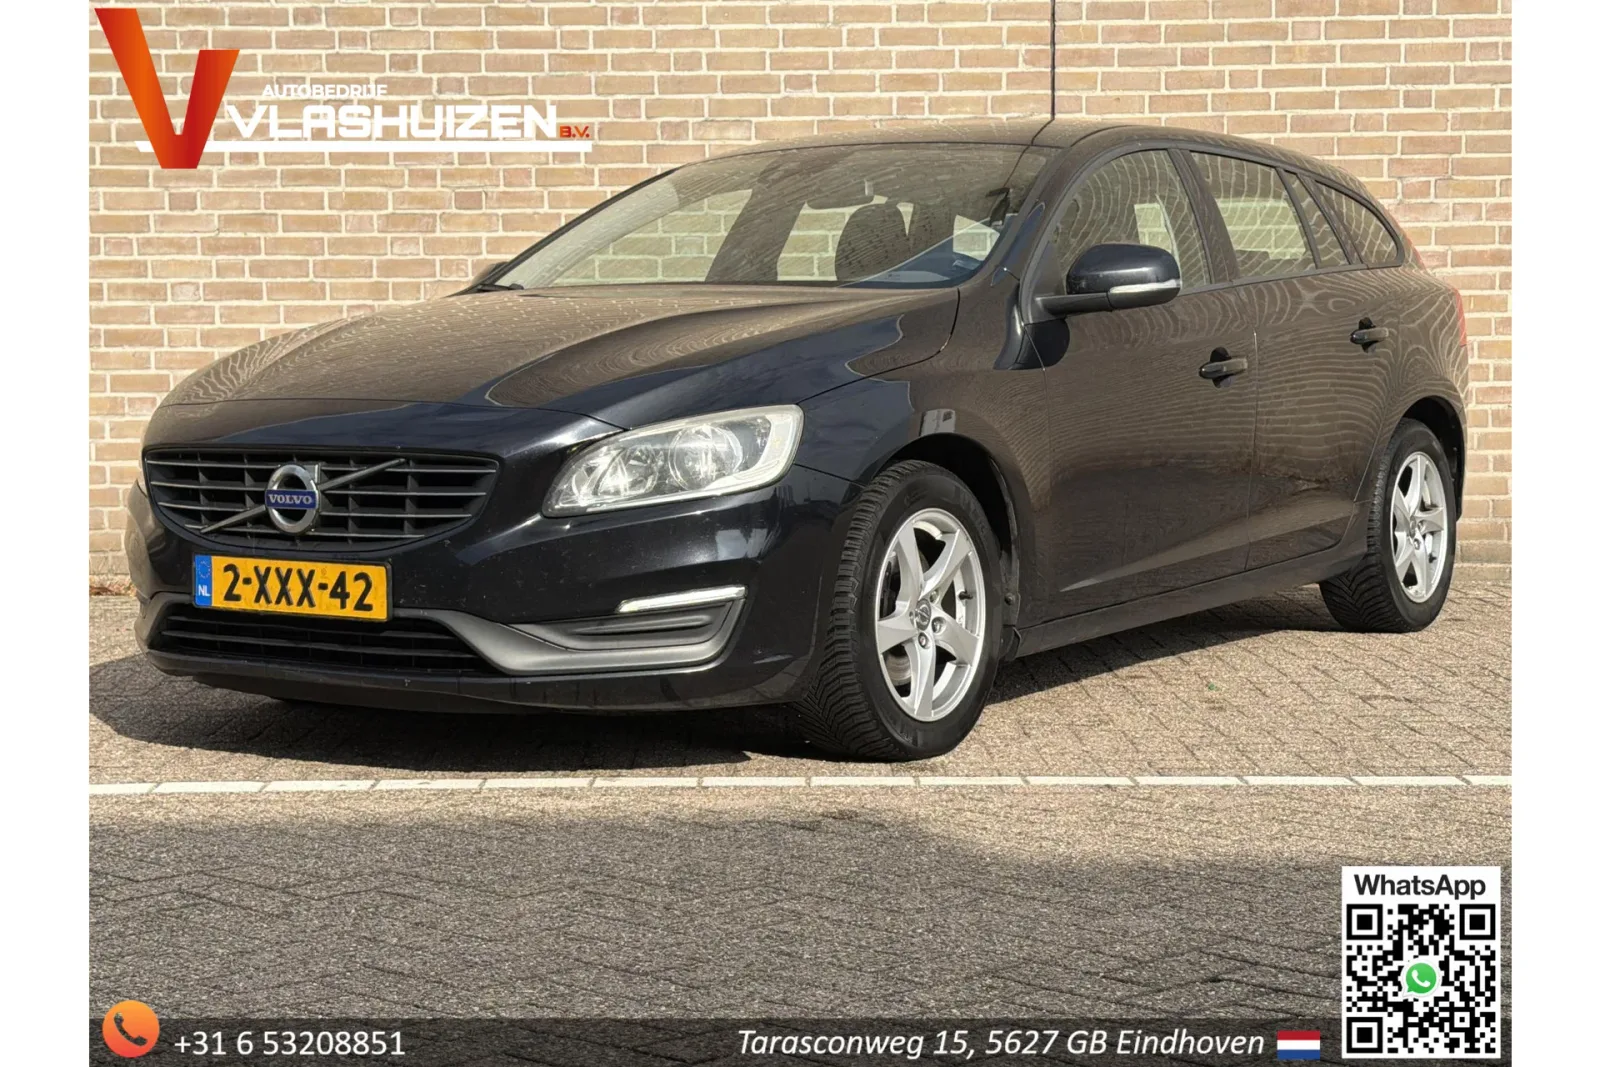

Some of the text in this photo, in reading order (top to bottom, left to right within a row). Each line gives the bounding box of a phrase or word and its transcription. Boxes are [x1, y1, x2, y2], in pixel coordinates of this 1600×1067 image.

[268, 494, 313, 505] VOLVO
[199, 585, 211, 597] NL
[223, 563, 374, 612] 2-XXX-42
